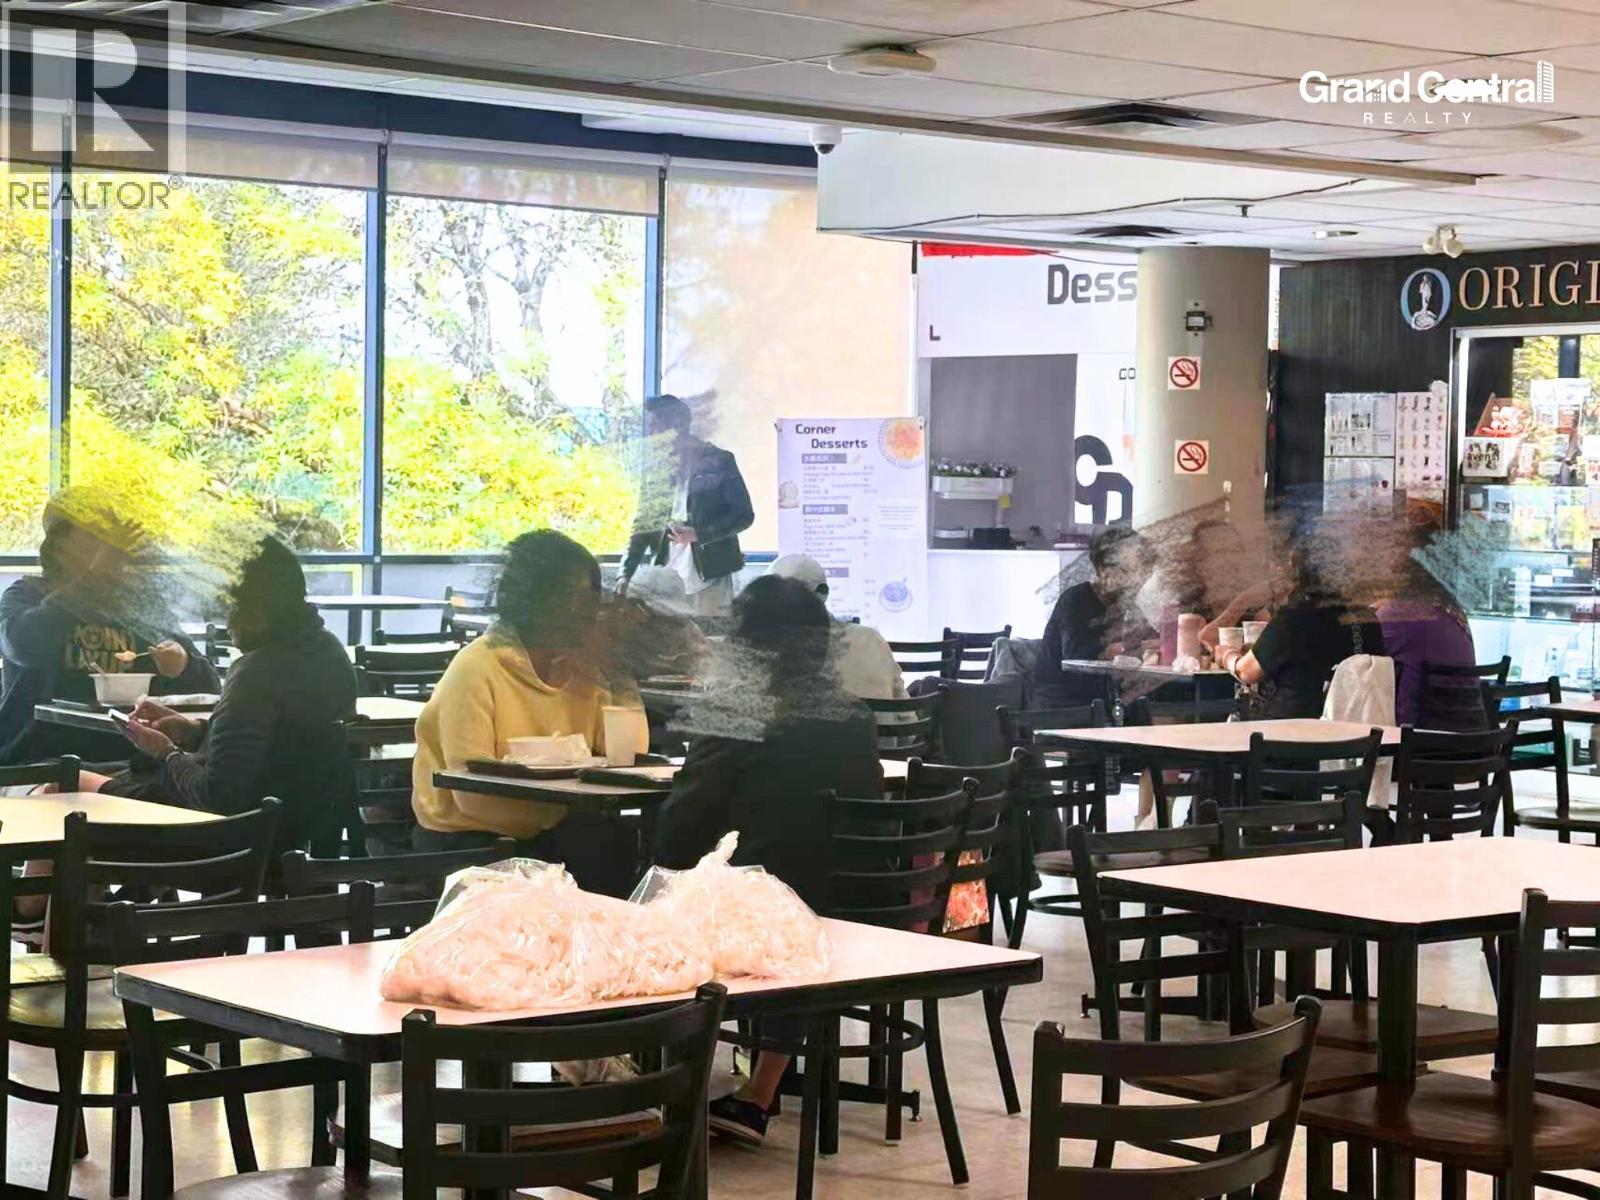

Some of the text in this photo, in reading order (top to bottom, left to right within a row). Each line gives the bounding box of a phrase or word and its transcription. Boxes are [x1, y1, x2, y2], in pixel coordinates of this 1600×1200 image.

[1047, 264, 1137, 305] Dess
[795, 423, 836, 435] Corner
[811, 438, 868, 449] Desserts
